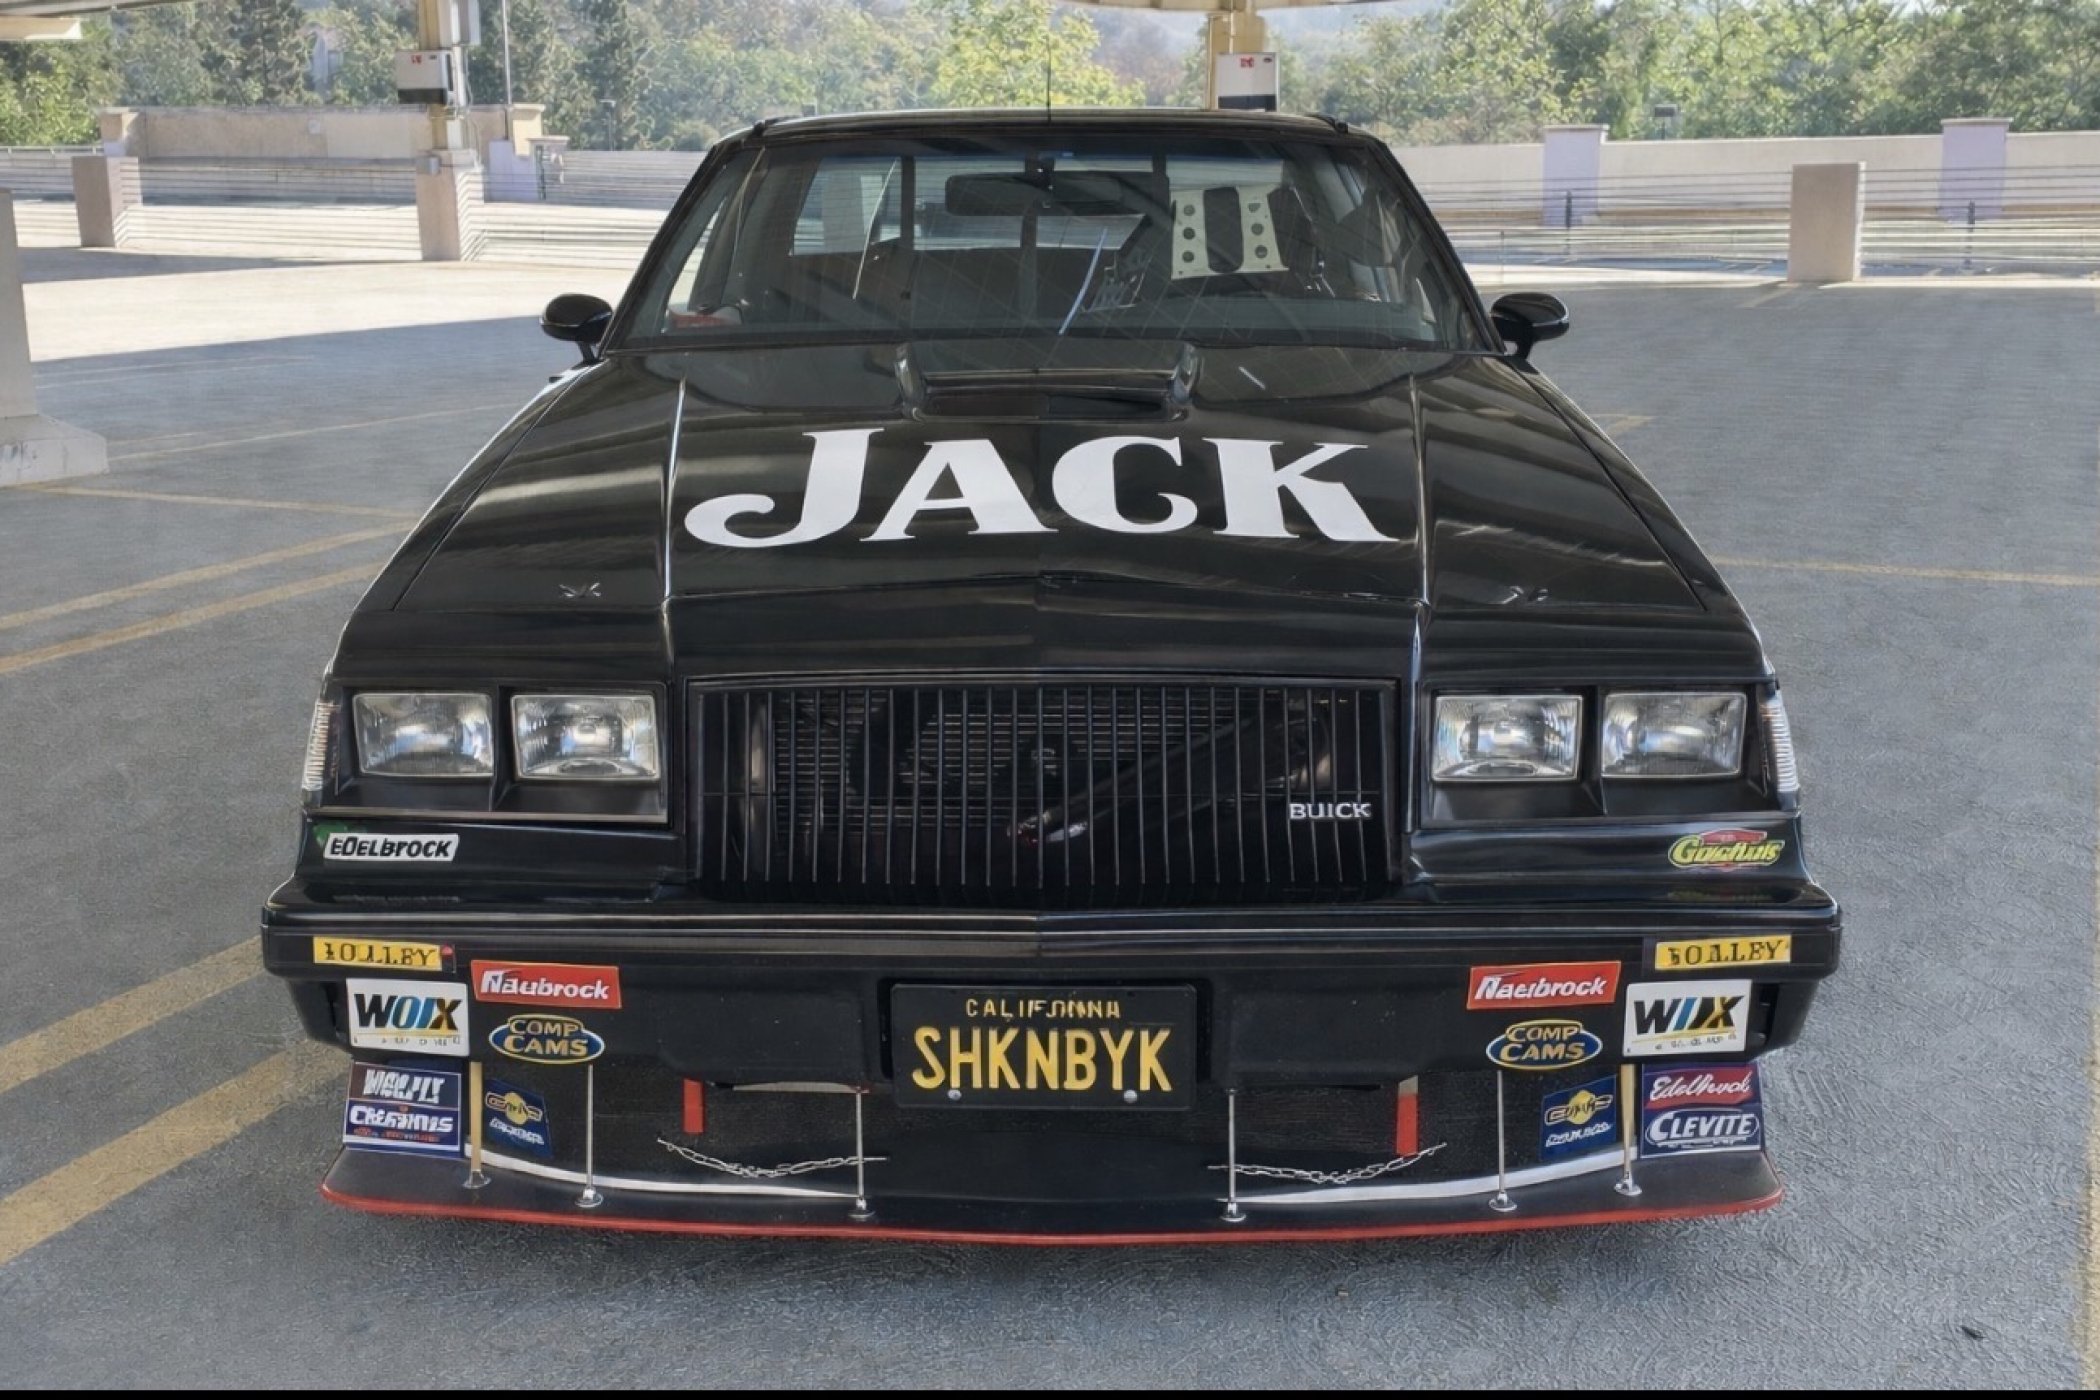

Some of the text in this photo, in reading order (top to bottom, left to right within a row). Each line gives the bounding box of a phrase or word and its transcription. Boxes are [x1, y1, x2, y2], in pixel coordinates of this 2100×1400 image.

[683, 427, 1400, 549] JACK
[1288, 803, 1372, 820] BUICK
[509, 1019, 579, 1037] COMP
[1506, 1026, 1580, 1042] COMP
[503, 1035, 589, 1057] CAMS
[1499, 1042, 1586, 1062] CAMS
[911, 1025, 1173, 1092] SHKNBYK
[1650, 1109, 1756, 1141] CLEVITE
